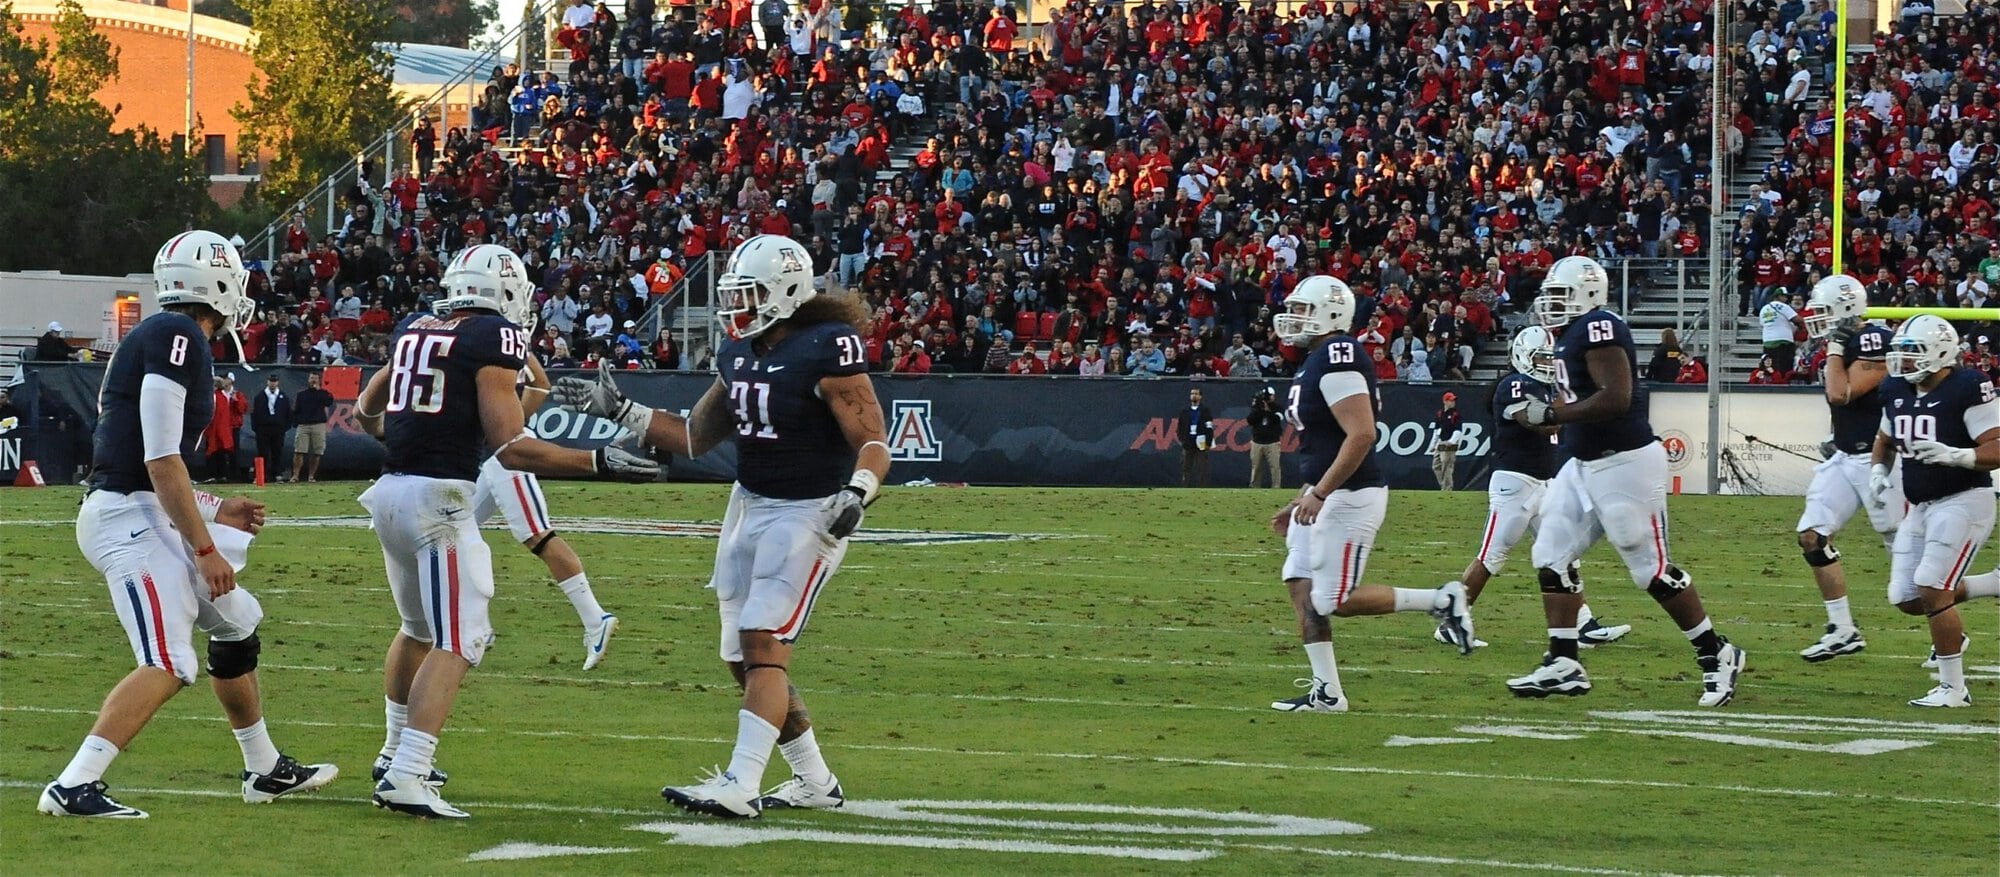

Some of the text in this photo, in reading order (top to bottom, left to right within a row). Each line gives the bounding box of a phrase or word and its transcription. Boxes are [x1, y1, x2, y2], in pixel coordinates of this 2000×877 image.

[210, 243, 232, 268] A
[497, 253, 518, 278] A
[779, 247, 802, 273] A
[500, 327, 526, 360] 85
[1587, 320, 1614, 343] 69
[1860, 332, 1883, 352] 68
[170, 335, 189, 367] 8
[836, 335, 864, 366] 31
[1328, 342, 1354, 364] 63
[383, 333, 457, 413] 85
[1511, 381, 1521, 398] 2
[730, 381, 779, 438] 31
[887, 400, 942, 462] A
[1894, 415, 1937, 458] 99
[1720, 442, 1766, 451] UNIVERSITY
[1741, 452, 1773, 461] CENTER
